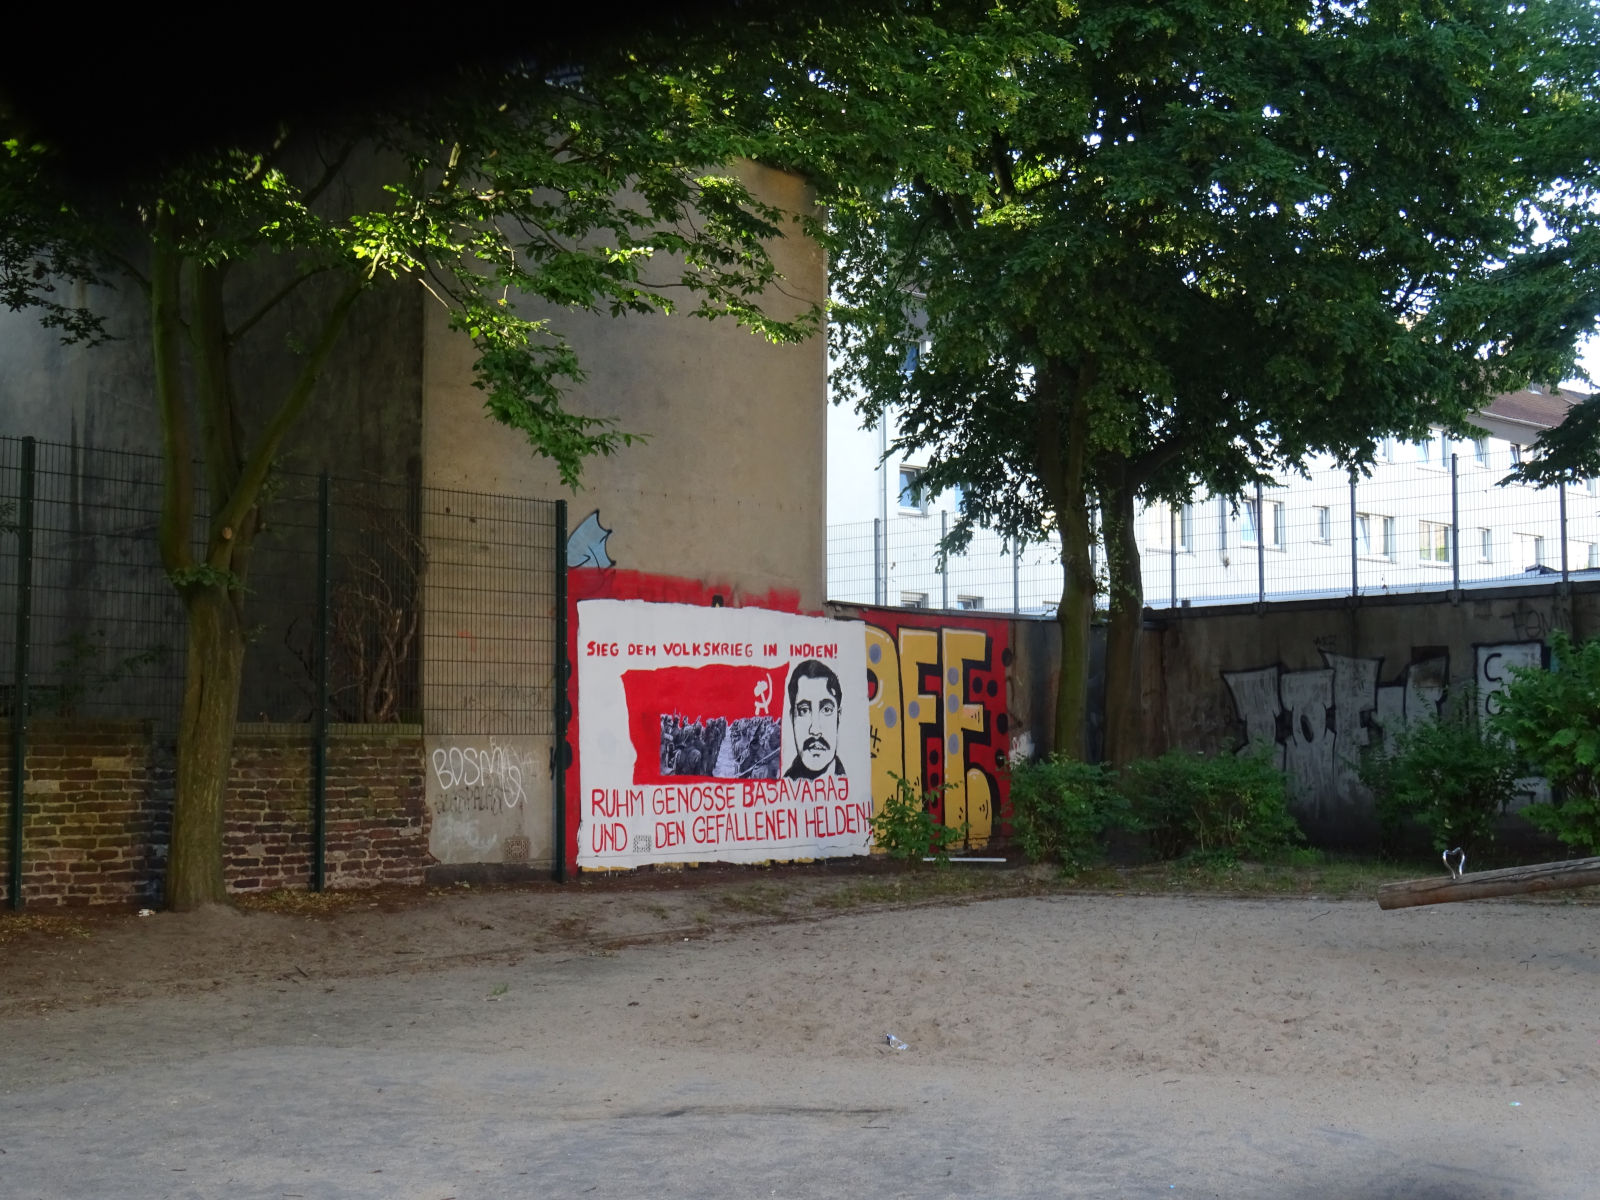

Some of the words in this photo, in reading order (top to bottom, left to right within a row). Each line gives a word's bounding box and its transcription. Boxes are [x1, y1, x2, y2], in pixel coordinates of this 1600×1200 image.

[586, 640, 620, 657] SIEG
[627, 643, 657, 657] DEM
[662, 642, 753, 658] VOLKSKRIEG
[763, 642, 778, 657] IN
[789, 643, 838, 659] INDIEN!
[591, 788, 645, 818] RUHM
[652, 785, 736, 816] GENOSSE
[592, 822, 628, 853] UND
[655, 821, 686, 849] DEN
[692, 808, 799, 845] GEFALLENEN
[804, 801, 874, 839] HELDEN!
